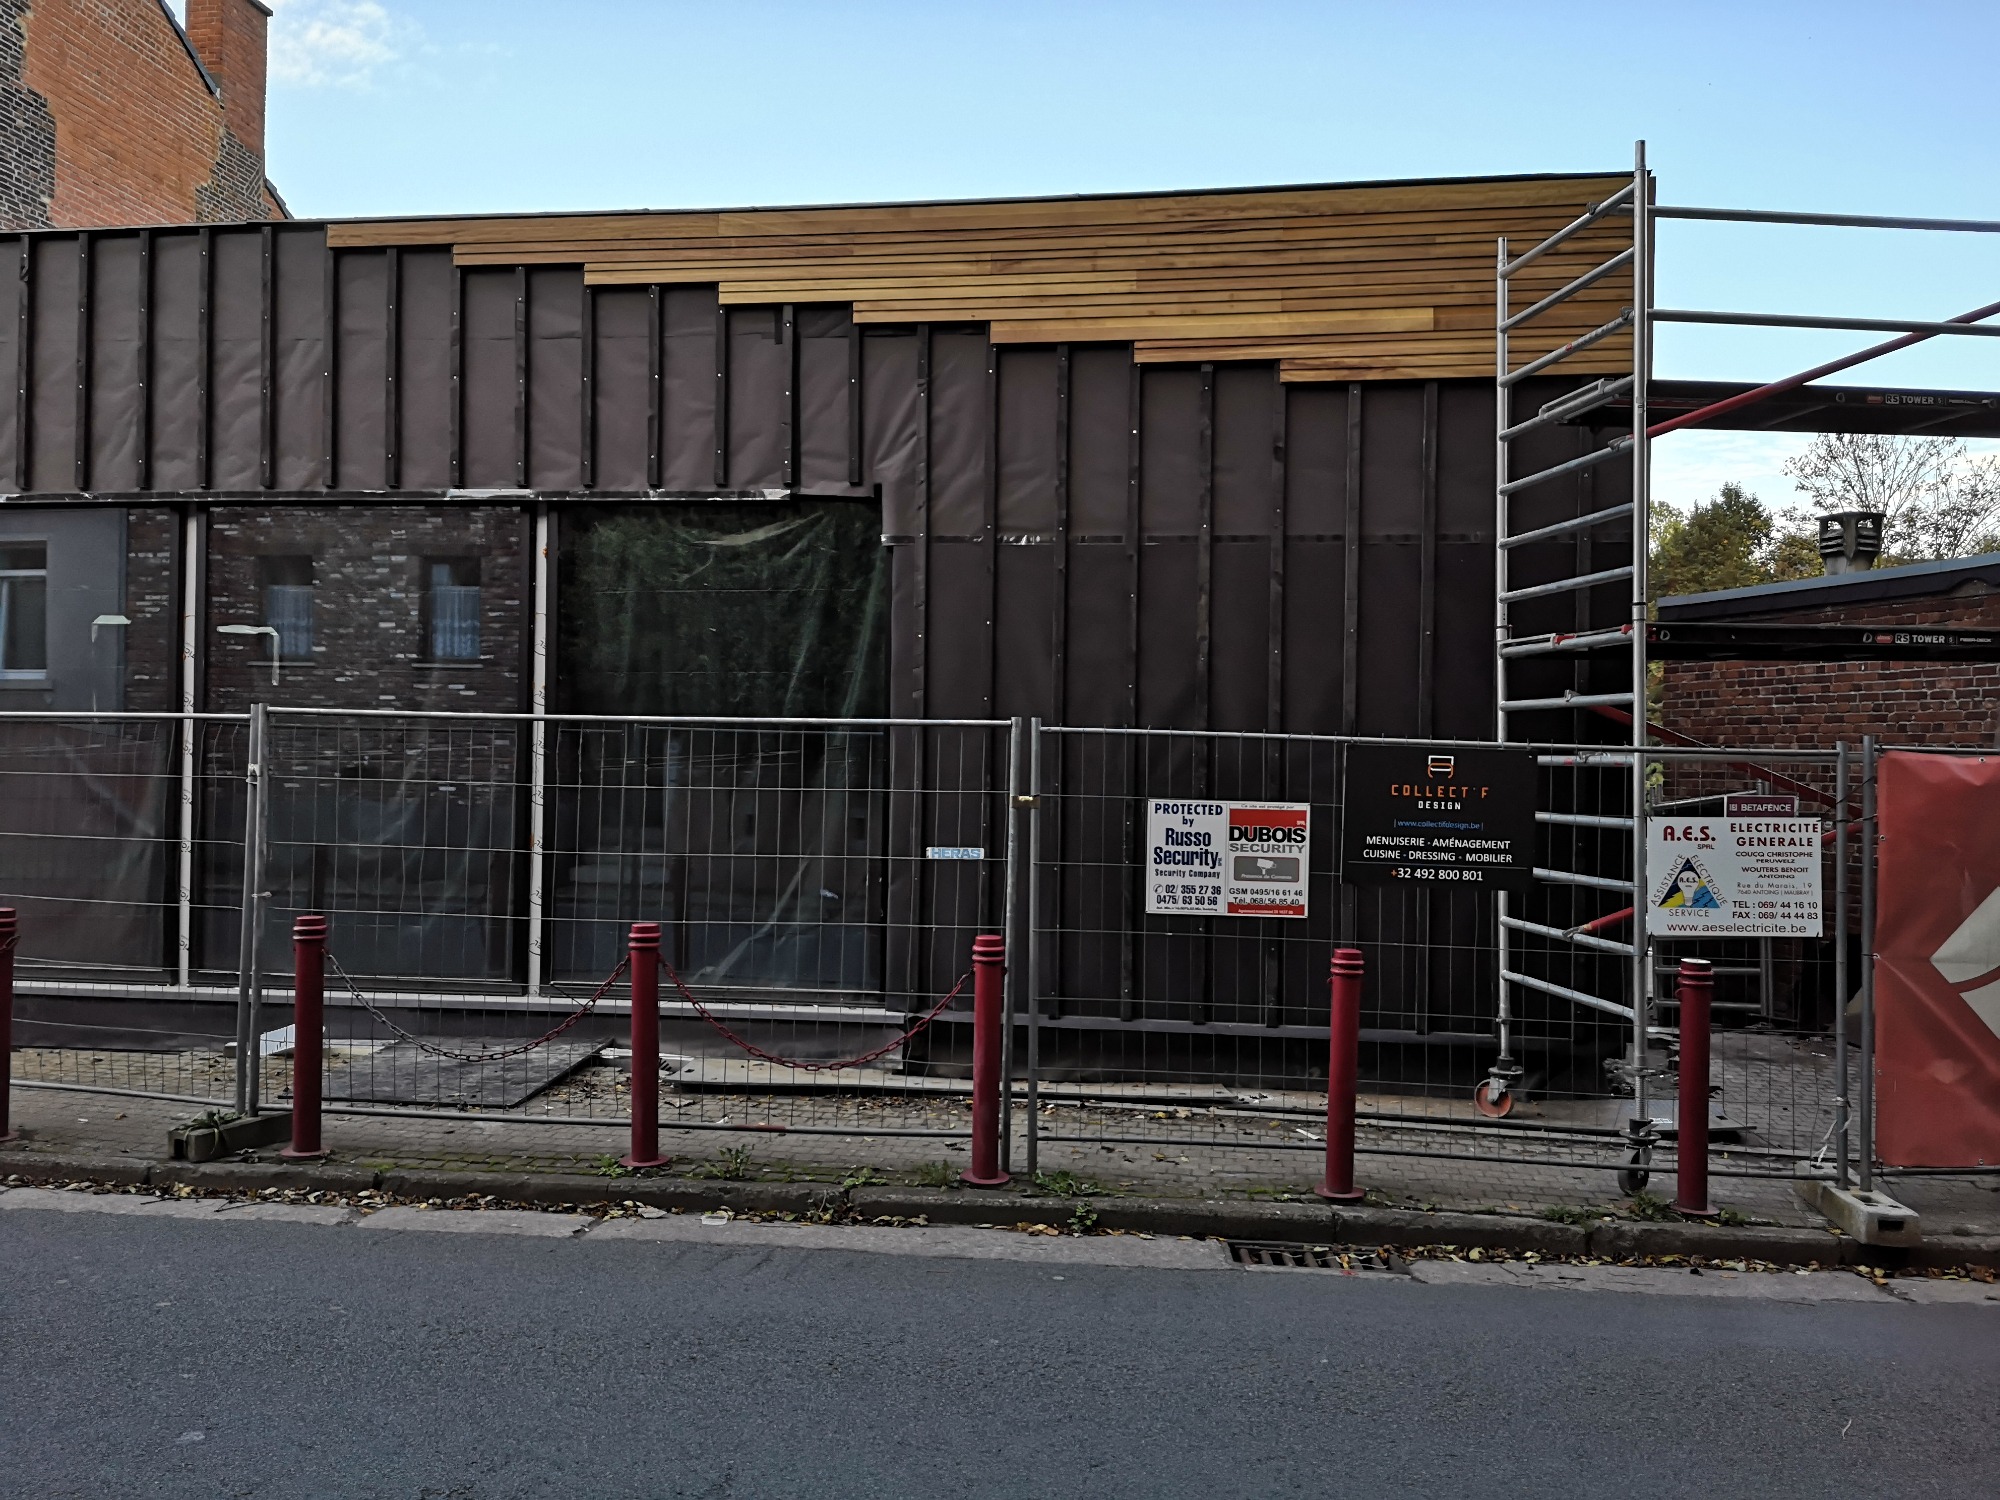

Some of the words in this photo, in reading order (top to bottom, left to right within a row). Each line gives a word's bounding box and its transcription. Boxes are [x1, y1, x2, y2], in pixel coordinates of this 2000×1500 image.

[1886, 396, 1899, 404] RS
[1902, 396, 1934, 404] TOWER
[1896, 634, 1908, 643] RS
[1912, 635, 1945, 643] TOWER
[1155, 803, 1222, 815] PROTECTED
[1418, 801, 1460, 810] DESIGN
[1741, 804, 1791, 812] BETAFENCE
[1182, 816, 1194, 827] by
[1398, 820, 1479, 829] www.collectifdesign.be
[1730, 823, 1818, 833] ELECTRICITE
[1166, 828, 1211, 846] Russo
[1229, 827, 1305, 843] DUBOIS
[1663, 826, 1716, 841] A.E.S.
[1366, 836, 1425, 846] MENUISERIE
[1433, 837, 1510, 849] AMÉNAGEMENT
[1737, 837, 1813, 847] GENERALE
[932, 848, 980, 858] HERAS
[1230, 843, 1304, 853] SECURITY
[1154, 847, 1218, 869] Security
[1363, 850, 1400, 858] CUISINE
[1409, 851, 1455, 861] DRESSING
[1466, 853, 1512, 863] MOBILIER
[1155, 869, 1186, 877] Security
[1189, 870, 1220, 879] Company
[1391, 868, 1410, 878] +32
[1414, 869, 1435, 879] 492
[1439, 870, 1459, 880] 800
[1463, 870, 1483, 881] 801
[1650, 853, 1685, 906] ASSISTANCE
[1691, 854, 1728, 906] ELECTRIQUE
[1166, 885, 1177, 894] 02/
[1181, 885, 1196, 894] 355
[1199, 886, 1208, 894] 27
[1211, 886, 1221, 895] 36
[1157, 895, 1180, 904] 0475/
[1182, 896, 1192, 905] 63
[1195, 896, 1206, 905] 50
[1669, 908, 1709, 917] SERVICE
[1667, 922, 1806, 933] www.aeselectricite.be
